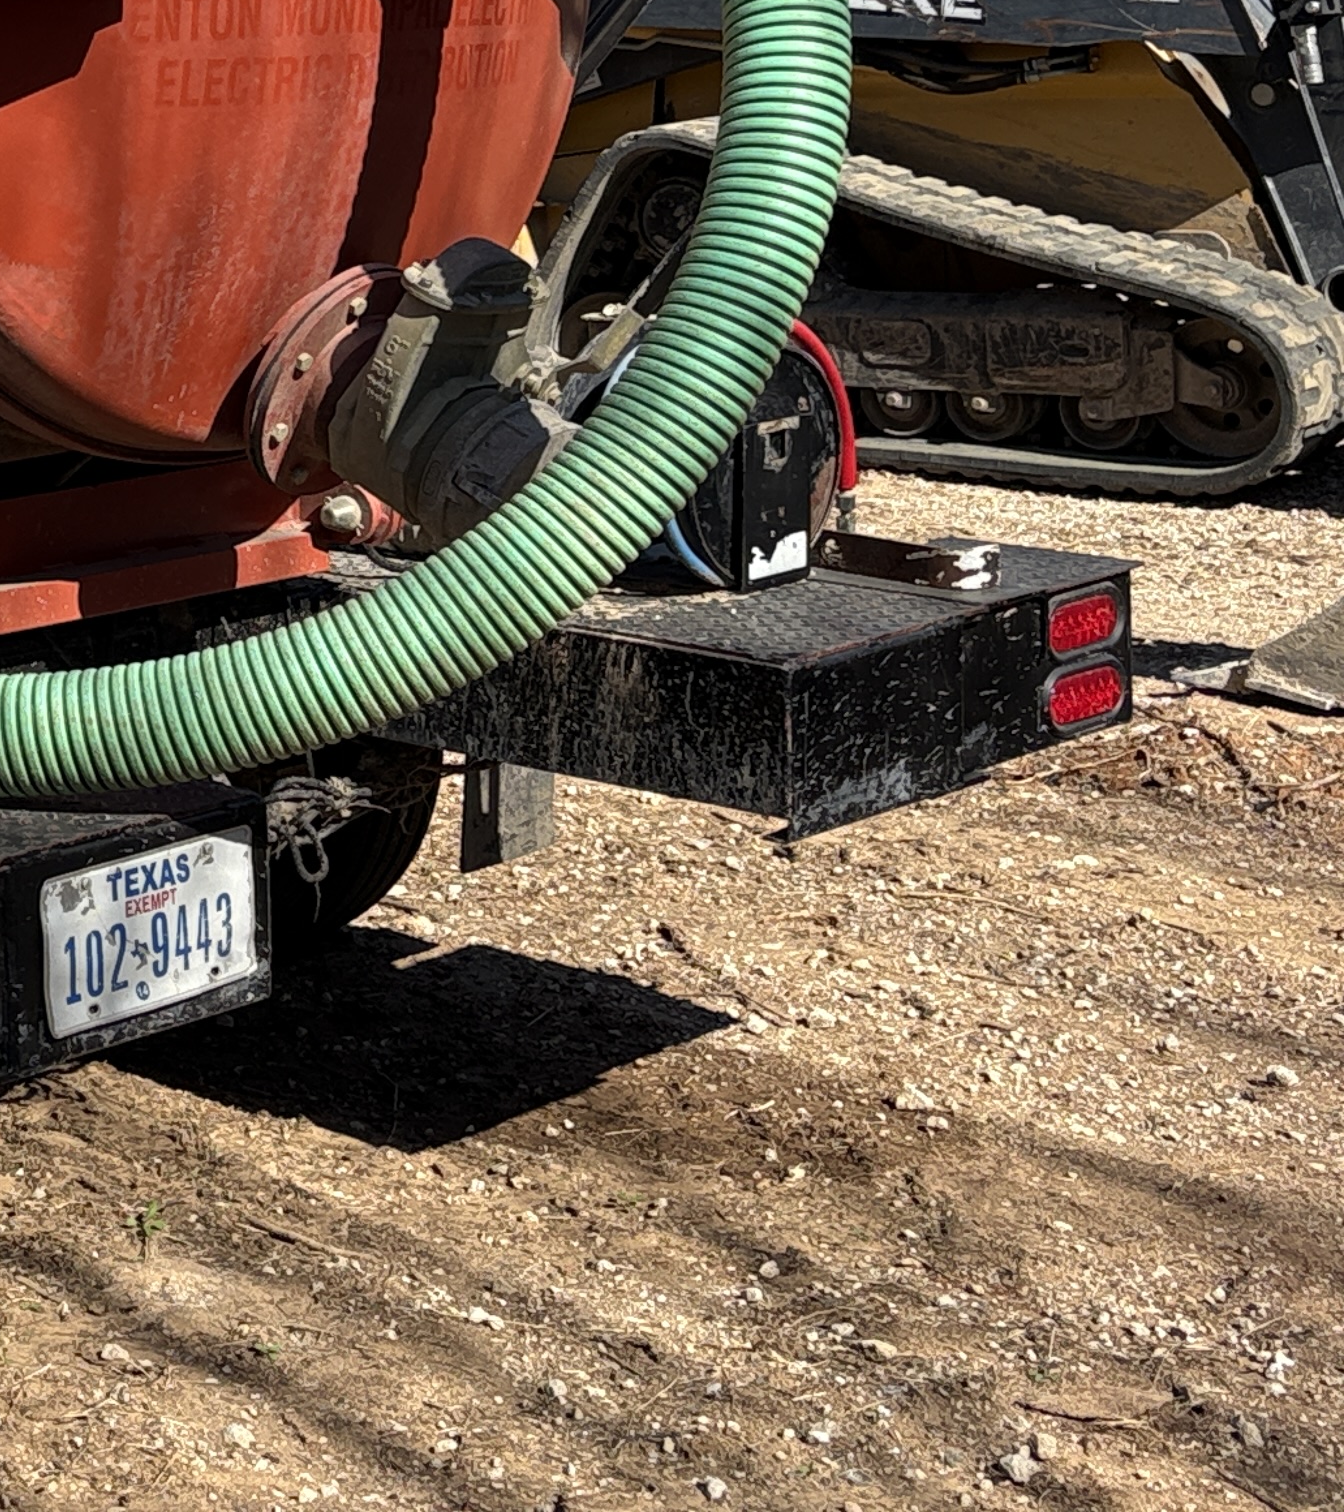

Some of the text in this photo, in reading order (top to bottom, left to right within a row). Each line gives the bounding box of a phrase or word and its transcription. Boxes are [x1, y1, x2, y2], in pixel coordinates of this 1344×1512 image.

[153, 38, 520, 107] ELECTRIC DBUTION
[107, 853, 191, 901] TEXAS
[124, 888, 178, 918] EXEMPT
